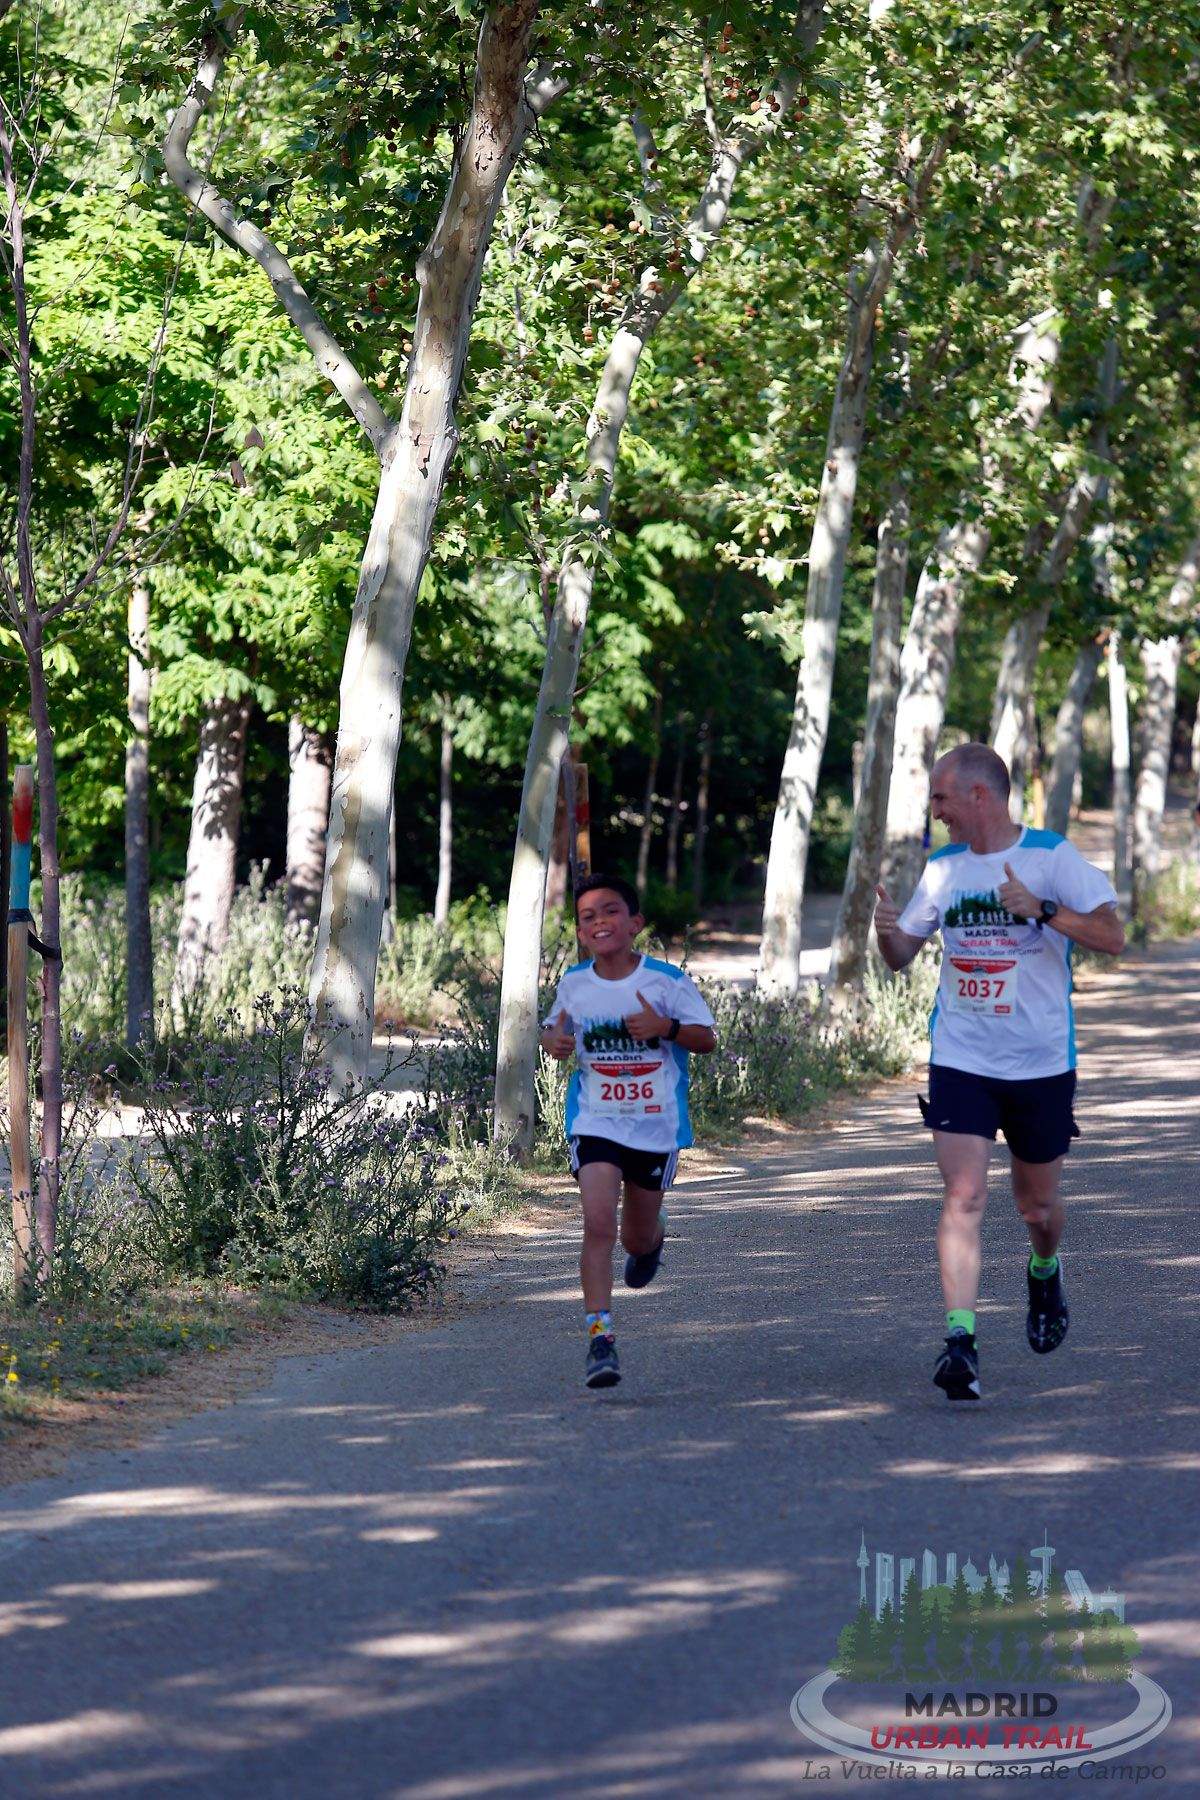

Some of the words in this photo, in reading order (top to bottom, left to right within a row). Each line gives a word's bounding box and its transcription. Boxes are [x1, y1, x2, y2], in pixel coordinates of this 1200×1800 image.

[964, 928, 1009, 937] MADRID
[958, 979, 1006, 998] 2037
[601, 1081, 654, 1101] 2036
